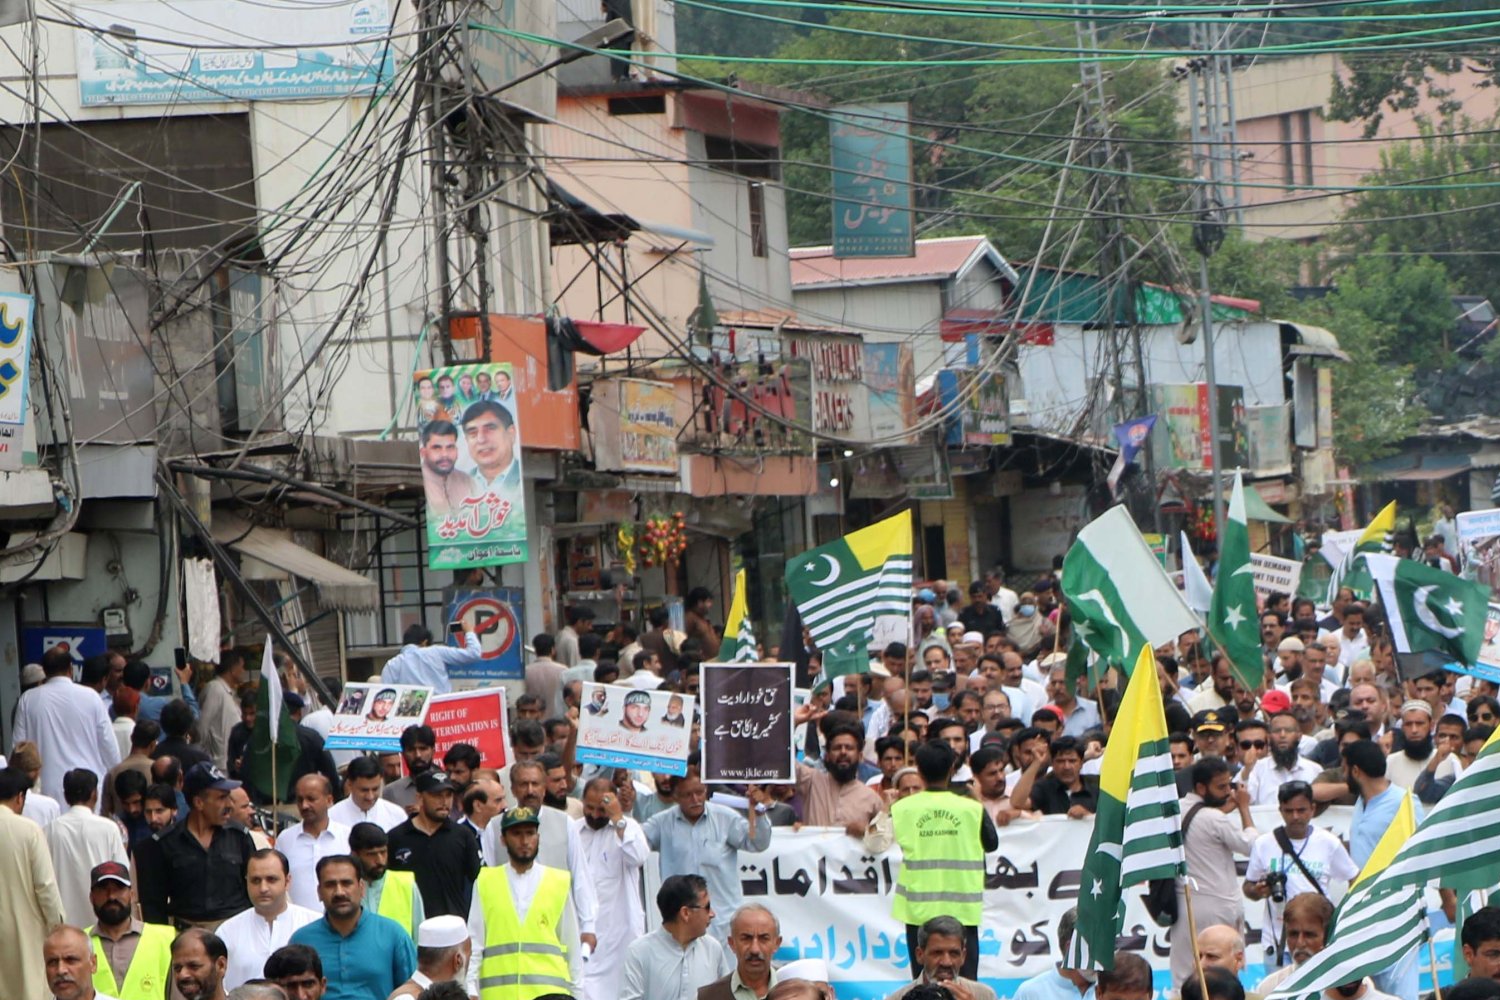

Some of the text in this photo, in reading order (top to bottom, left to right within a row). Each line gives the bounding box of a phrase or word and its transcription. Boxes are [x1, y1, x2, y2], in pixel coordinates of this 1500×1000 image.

[437, 492, 511, 538] خوش آمدید
[763, 688, 779, 706] حق
[430, 708, 468, 722] RIGHT OF
[433, 719, 498, 737] TERMINATION IS
[714, 724, 730, 741] ہے
[730, 720, 744, 738] حق
[741, 855, 892, 897] اقدامات
[1007, 919, 1051, 966] کو
